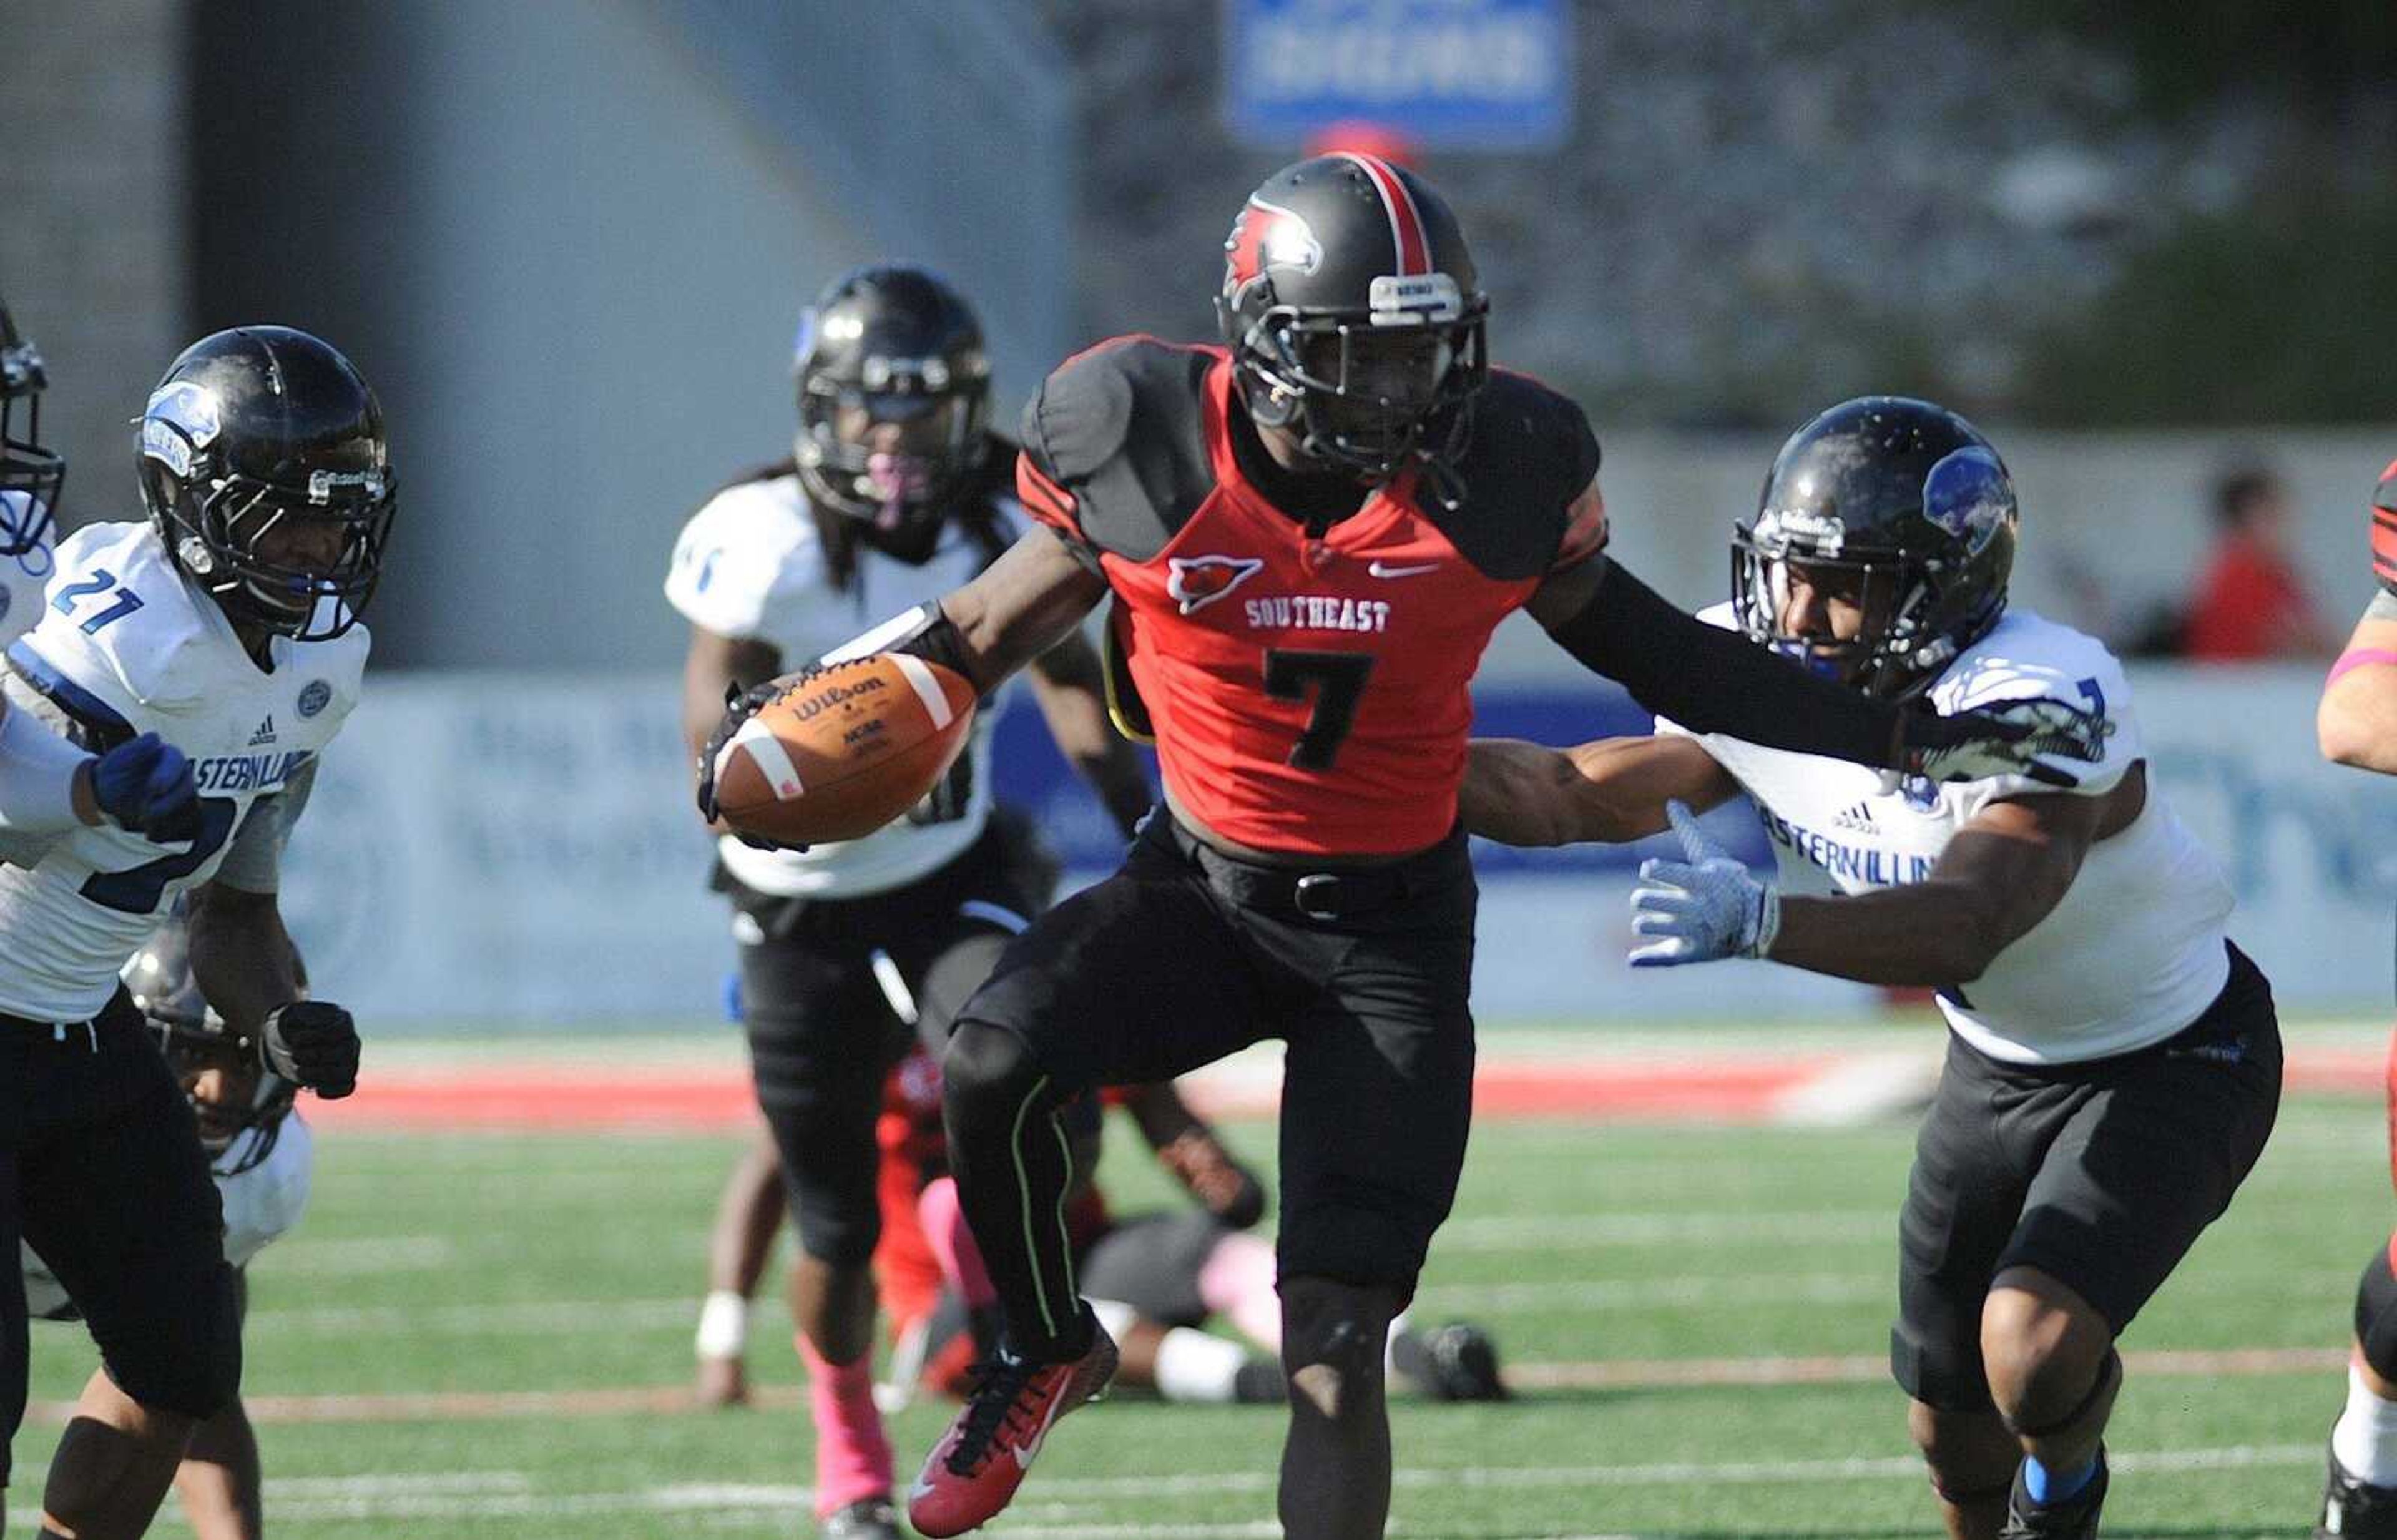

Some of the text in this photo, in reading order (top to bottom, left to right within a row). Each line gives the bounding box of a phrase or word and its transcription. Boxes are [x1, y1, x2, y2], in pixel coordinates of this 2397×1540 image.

[1245, 596, 1391, 632] SOUTHEAST
[793, 676, 885, 722] Wilson
[1262, 647, 1378, 770] 7
